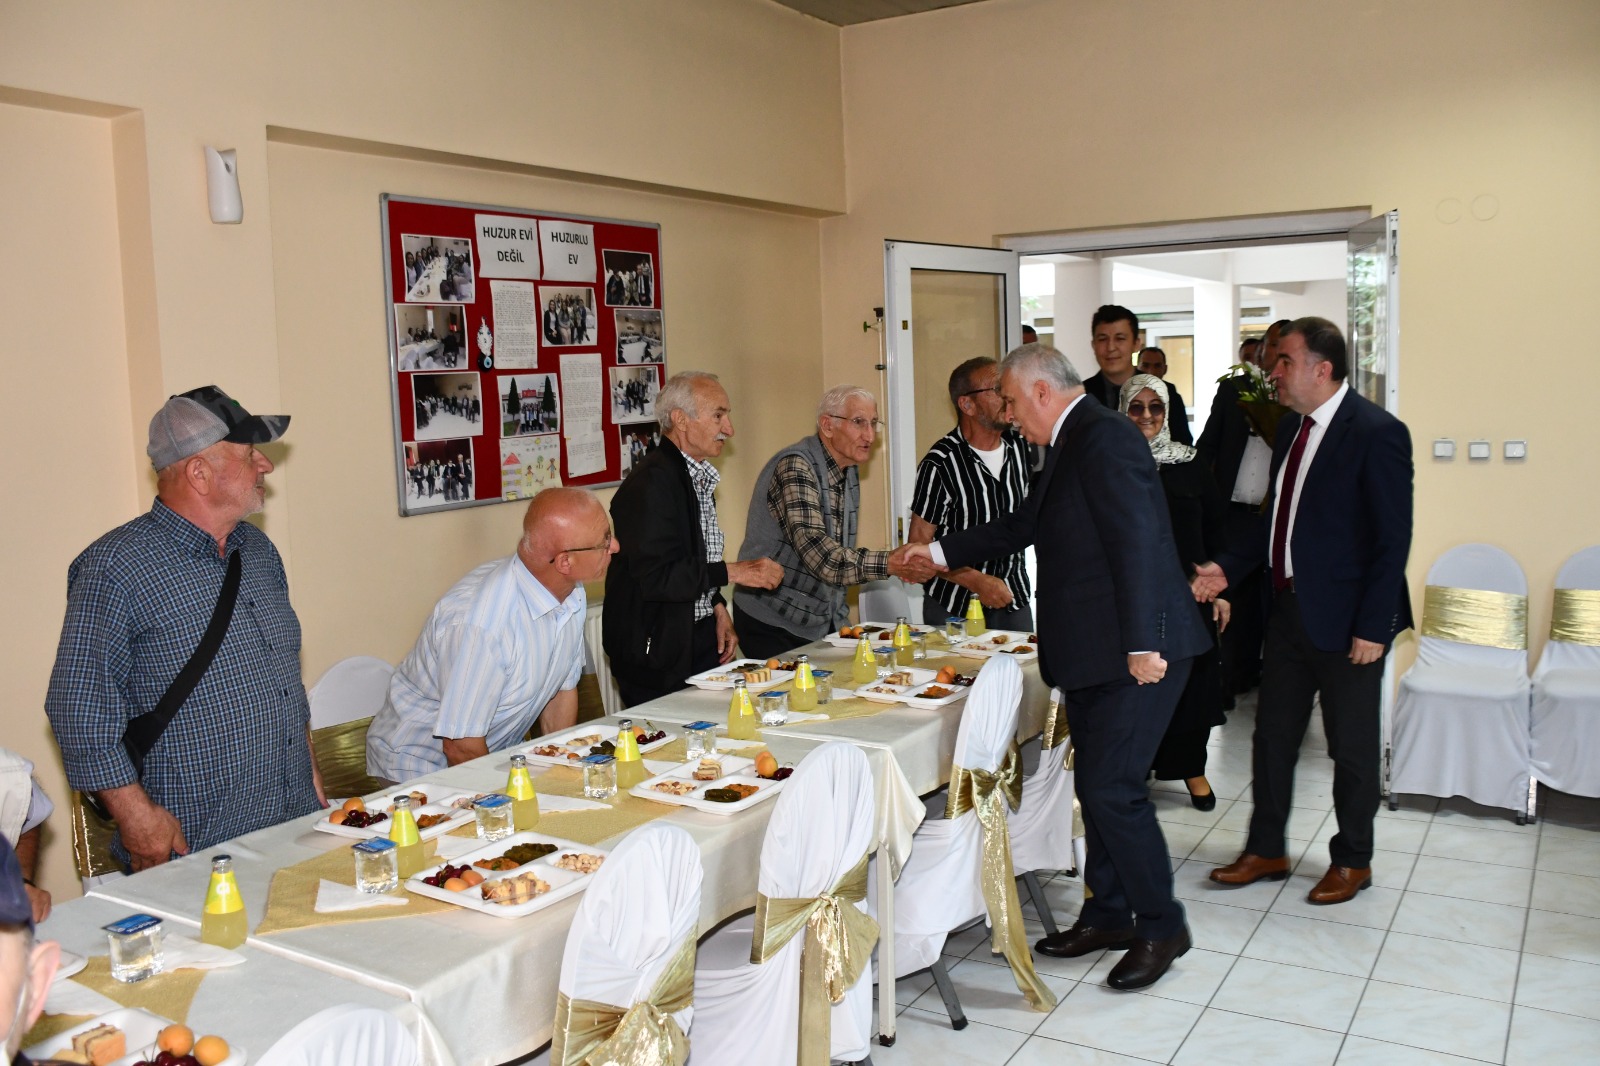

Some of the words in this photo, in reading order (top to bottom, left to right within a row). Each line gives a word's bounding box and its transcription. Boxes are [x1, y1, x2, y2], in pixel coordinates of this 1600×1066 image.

[482, 226, 517, 240] HUZUR
[519, 227, 534, 241] EVİ
[551, 231, 589, 246] HUZURLU
[497, 248, 525, 263] DEĞİL
[568, 253, 579, 265] EV
